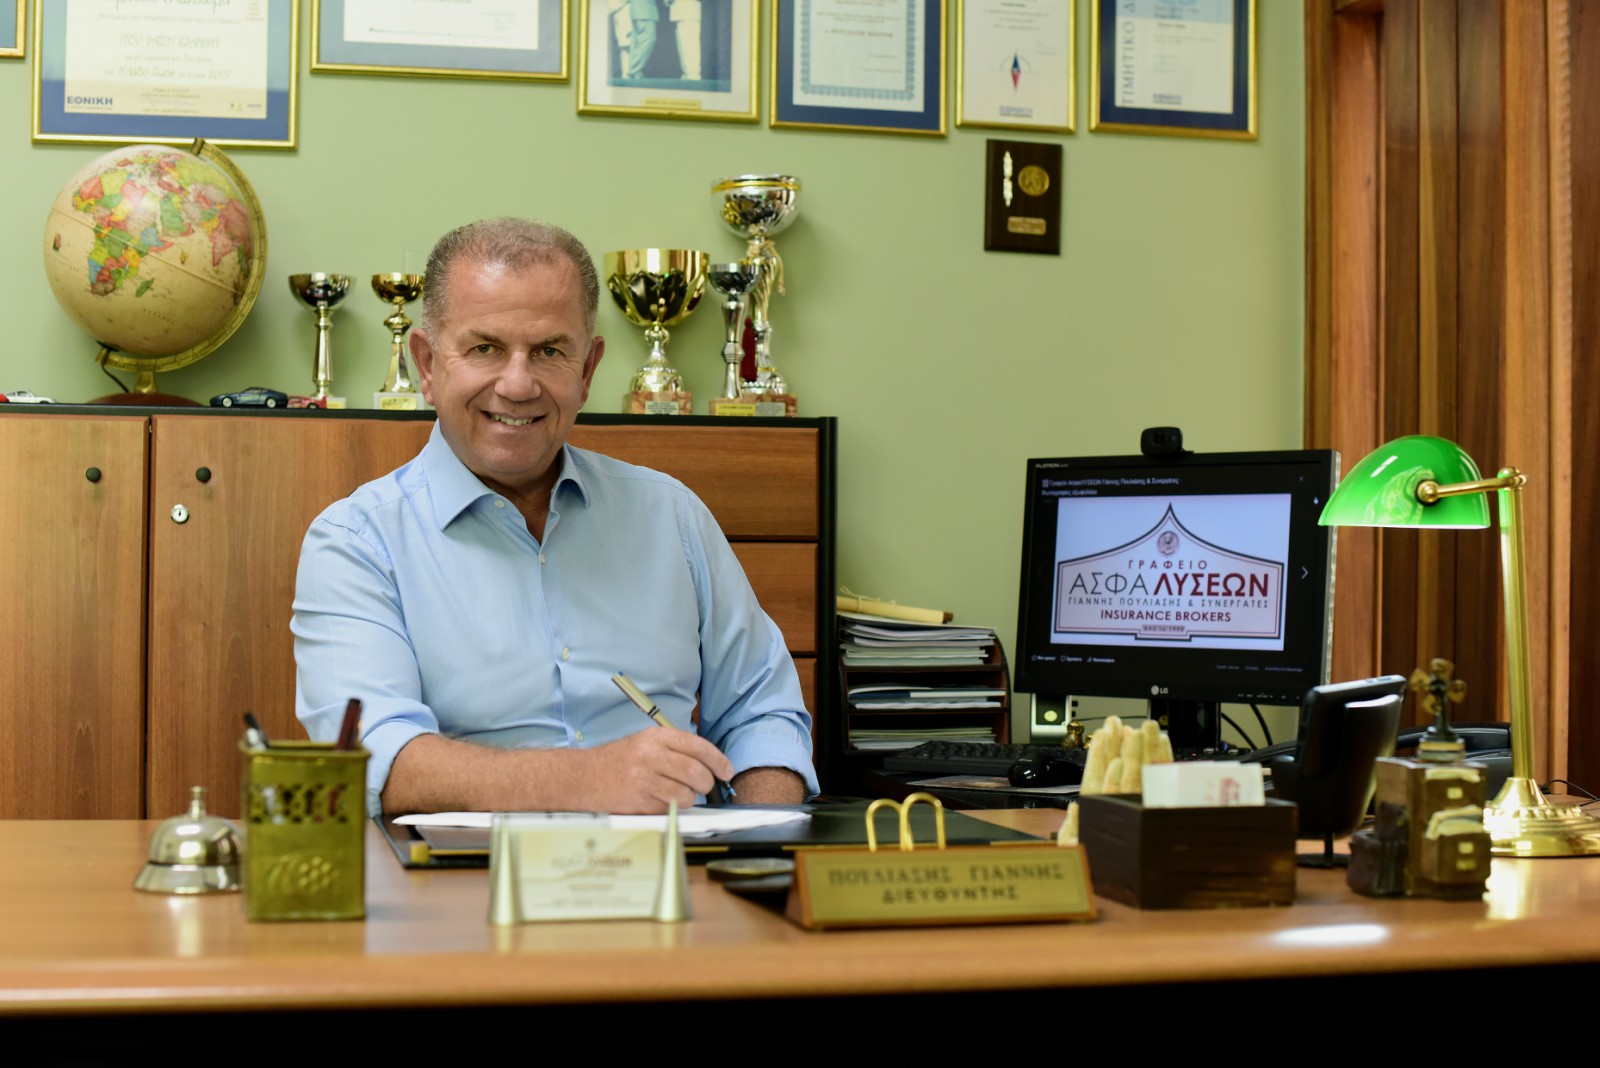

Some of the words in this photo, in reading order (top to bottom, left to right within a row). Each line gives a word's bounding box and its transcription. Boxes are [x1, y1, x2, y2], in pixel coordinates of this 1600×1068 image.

[1128, 560, 1208, 570] ΓΡΑΦΕΙΟ
[1068, 597, 1113, 605] ΓΙΑΝΝΗΣ
[1119, 598, 1181, 606] ΠΟΥΛΙΑΣΗΣ
[1188, 599, 1194, 607] &
[1201, 599, 1269, 608] ΣΥΝΕΡΓΑΤΕΣ
[1101, 610, 1171, 621] INSURANCE
[1175, 611, 1232, 622] BROKERS
[828, 866, 951, 886] ΠΟΥΛΙΑΣΗΣ
[969, 863, 1065, 882] ΓΙΑΝΝΗΣ
[882, 884, 1019, 904] ΔΙΕΥΘΥΝΤΗΣ
